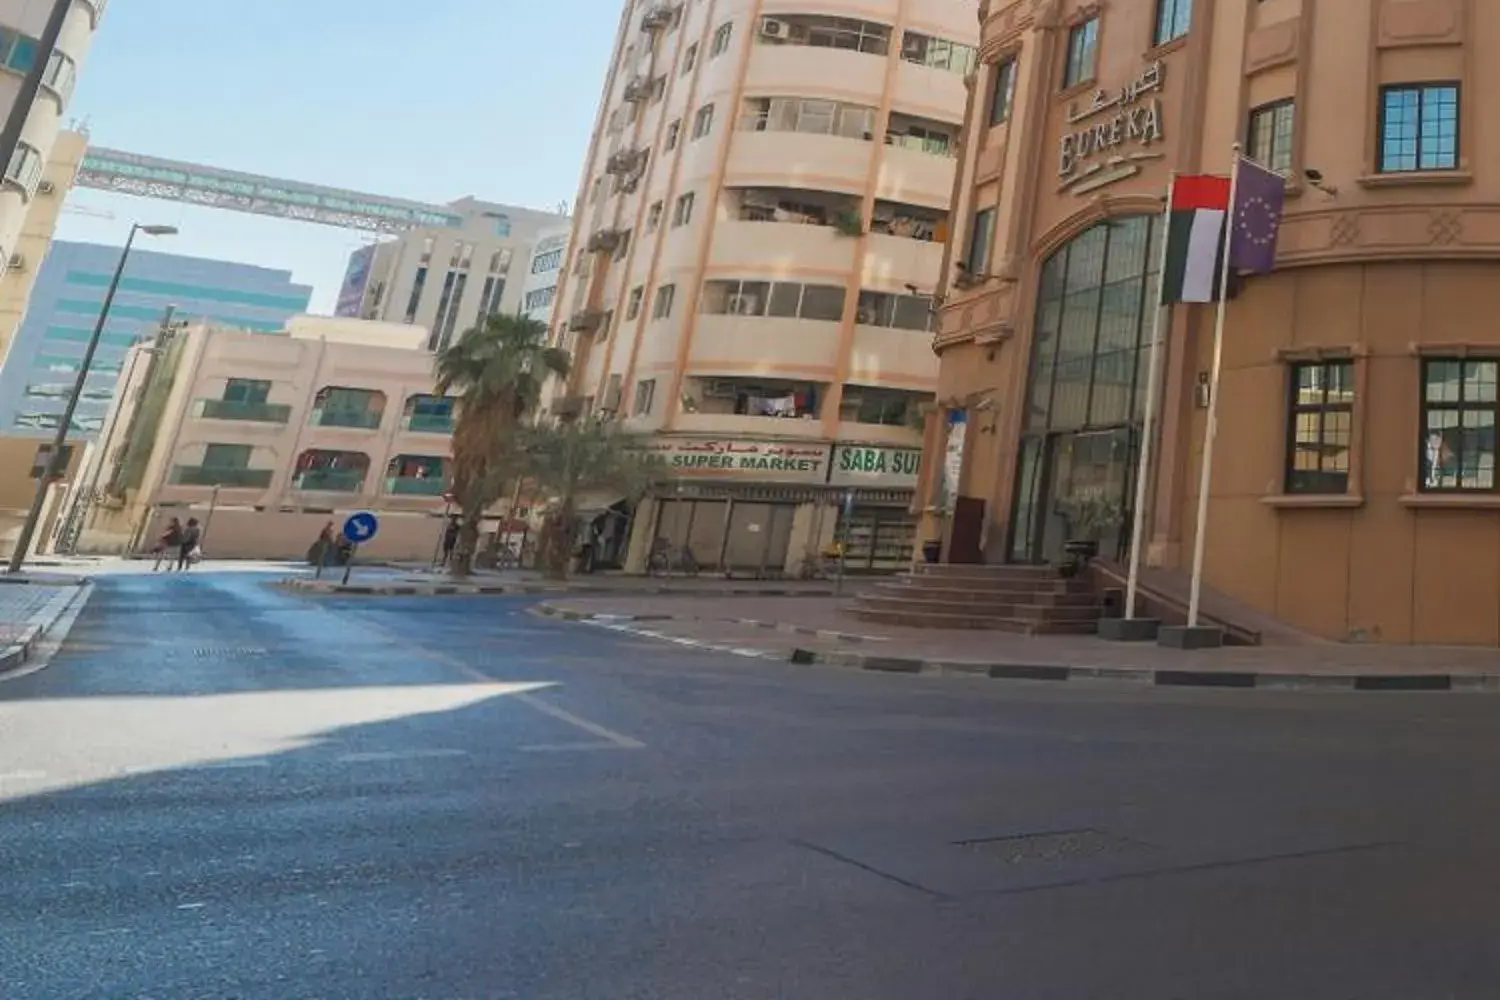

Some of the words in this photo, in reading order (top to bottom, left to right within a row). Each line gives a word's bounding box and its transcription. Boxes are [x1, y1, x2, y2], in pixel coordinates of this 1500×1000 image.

[1059, 98, 1162, 175] EUREKA
[671, 455, 734, 469] SUPER
[739, 457, 822, 472] MARKET
[840, 447, 886, 473] SABA
